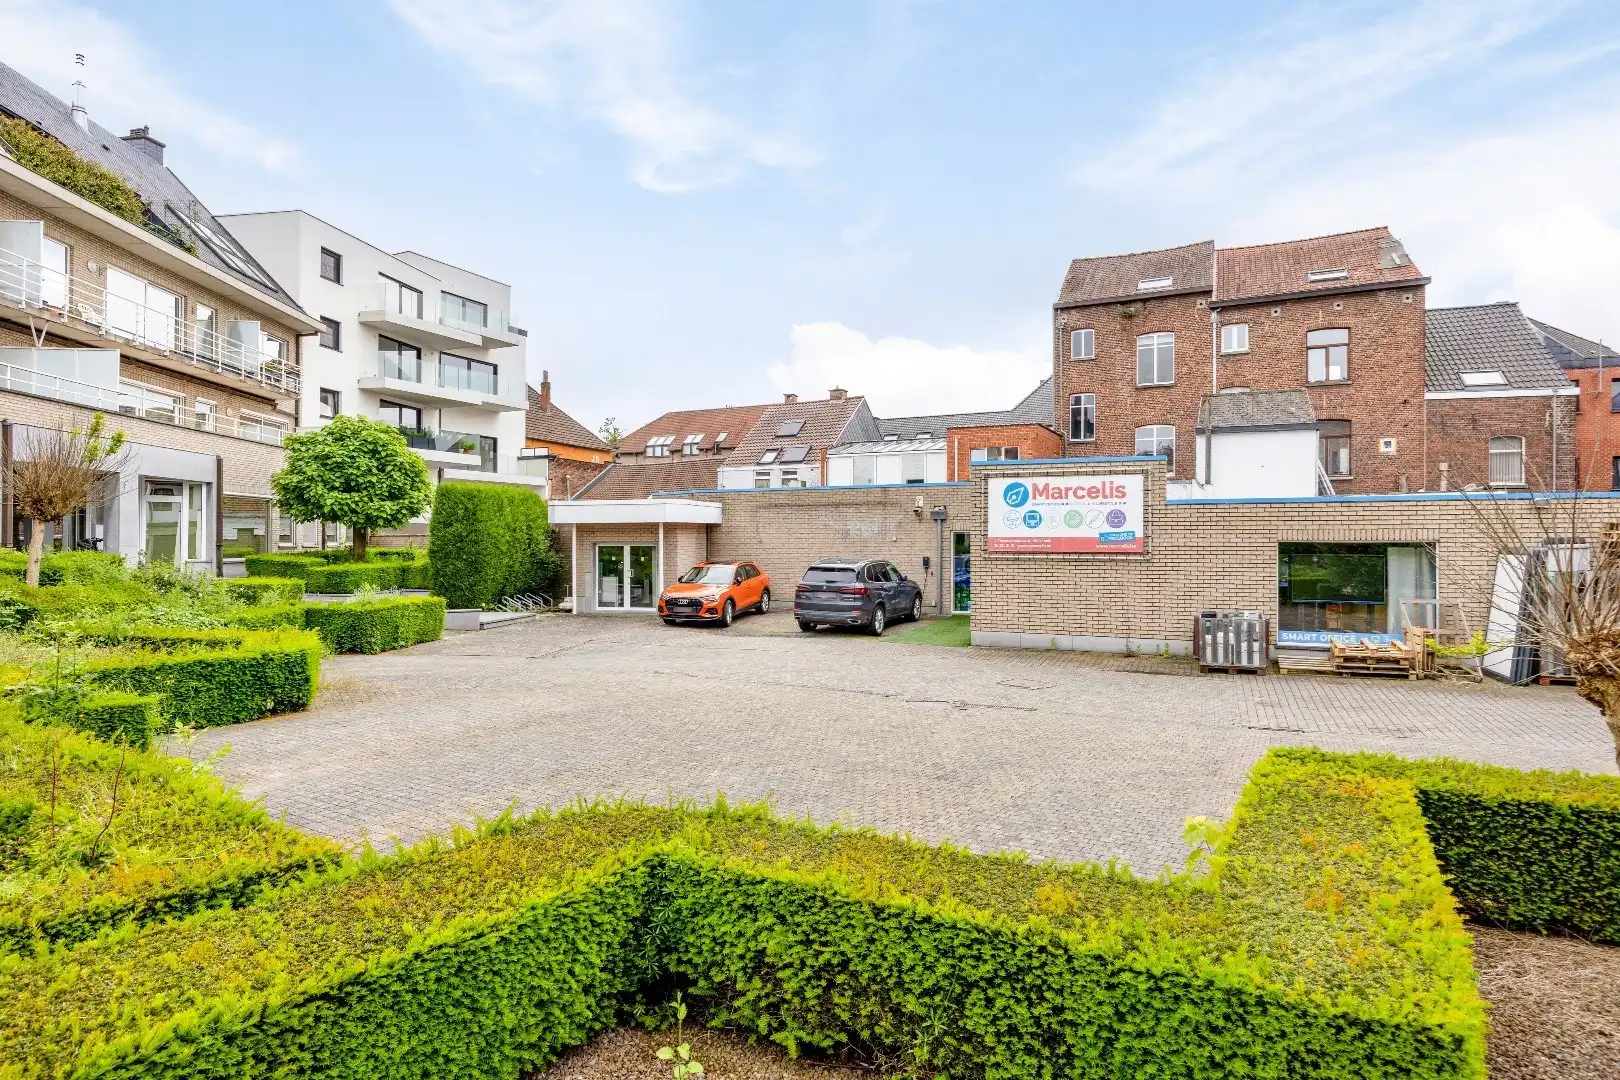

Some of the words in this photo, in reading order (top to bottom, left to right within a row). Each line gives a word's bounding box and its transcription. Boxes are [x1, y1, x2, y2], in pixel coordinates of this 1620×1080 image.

[1031, 481, 1127, 500] Marcelis
[1281, 632, 1318, 641] SMART
[1319, 633, 1357, 643] OFFICE
